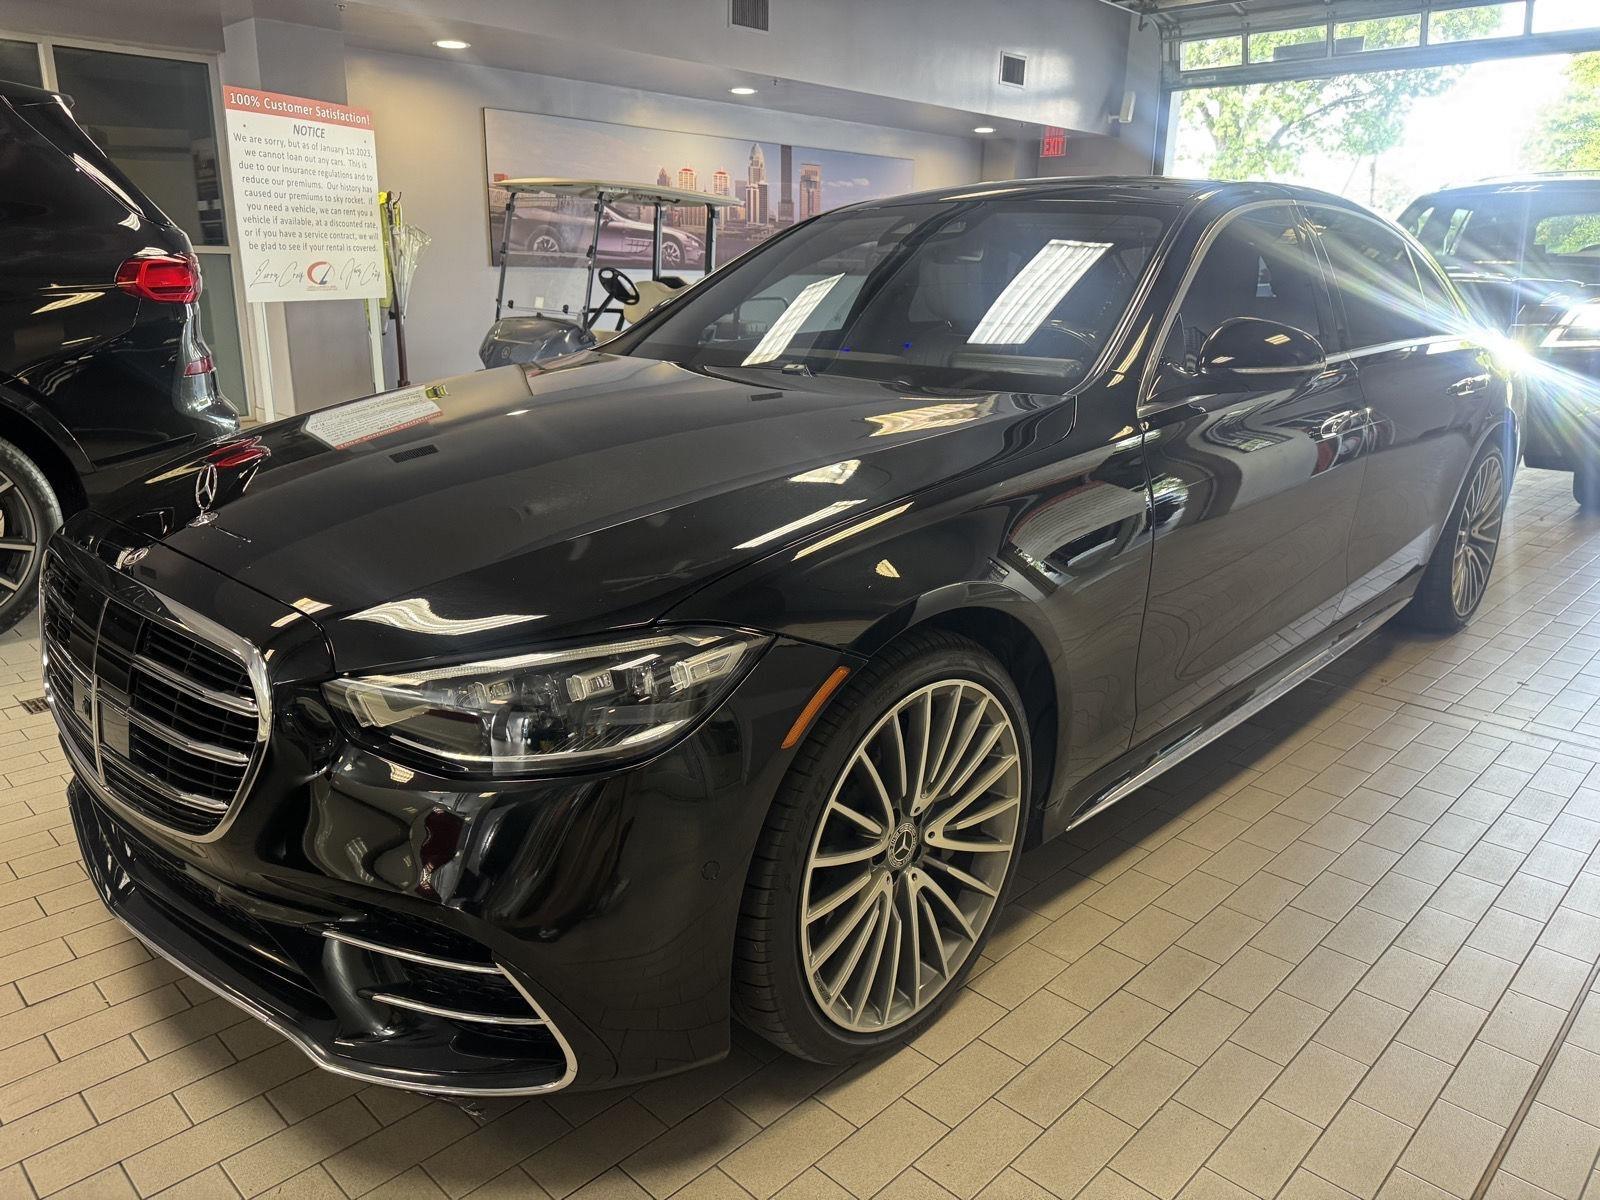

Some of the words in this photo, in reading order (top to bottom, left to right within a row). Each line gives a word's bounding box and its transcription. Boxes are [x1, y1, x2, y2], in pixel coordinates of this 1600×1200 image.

[230, 92, 261, 108] 100%
[264, 97, 313, 115] Customer
[315, 105, 370, 125] Satisfaction!
[293, 124, 326, 139] NOTICE
[233, 132, 247, 143] We
[249, 136, 262, 144] are
[264, 137, 286, 149] sorry,
[288, 138, 300, 149] but
[302, 142, 310, 150] as
[311, 142, 319, 151] of
[320, 143, 344, 156] January
[345, 146, 355, 156] 1st
[1044, 137, 1065, 156] EXIT
[244, 149, 256, 157] we
[258, 150, 285, 160] cannot
[286, 151, 303, 161] loan
[304, 155, 316, 163] out
[317, 156, 329, 166] any
[348, 159, 361, 168] This
[361, 161, 367, 169] is
[238, 160, 254, 170] due
[256, 163, 265, 171] to
[267, 164, 279, 172] our
[282, 163, 317, 176] insurance
[317, 168, 353, 180] regulations
[354, 172, 365, 181] and
[366, 174, 373, 182] to
[242, 174, 270, 185] reduce
[272, 178, 285, 186] our
[287, 179, 323, 190] premiums.
[327, 181, 339, 190] Our
[340, 182, 361, 193] history
[362, 184, 373, 193] has
[244, 188, 272, 198] caused
[273, 190, 287, 199] our
[288, 192, 324, 202] premiums
[333, 194, 344, 205] sky
[345, 196, 366, 205] rocket.
[246, 202, 262, 212] you
[263, 203, 283, 212] need
[290, 204, 318, 216] vehicle,
[319, 207, 330, 215] we
[330, 207, 342, 216] can
[343, 208, 356, 217] rent
[356, 209, 369, 219] you
[242, 214, 271, 224] vehicle
[272, 215, 279, 225] if
[280, 216, 314, 228] available,
[315, 219, 322, 227] at
[329, 219, 364, 229] discounted
[364, 221, 379, 230] rate,
[244, 229, 253, 237] or
[255, 227, 261, 237] if
[262, 229, 278, 239] you
[279, 229, 297, 238] have
[304, 231, 329, 240] service
[329, 231, 358, 241] contract,
[368, 231, 379, 241] will
[248, 241, 259, 250] be
[260, 242, 277, 252] glad
[278, 242, 287, 251] to
[288, 243, 301, 251] see
[302, 241, 308, 251] if
[308, 243, 325, 253] your
[325, 243, 345, 252] rental
[346, 244, 352, 252] is
